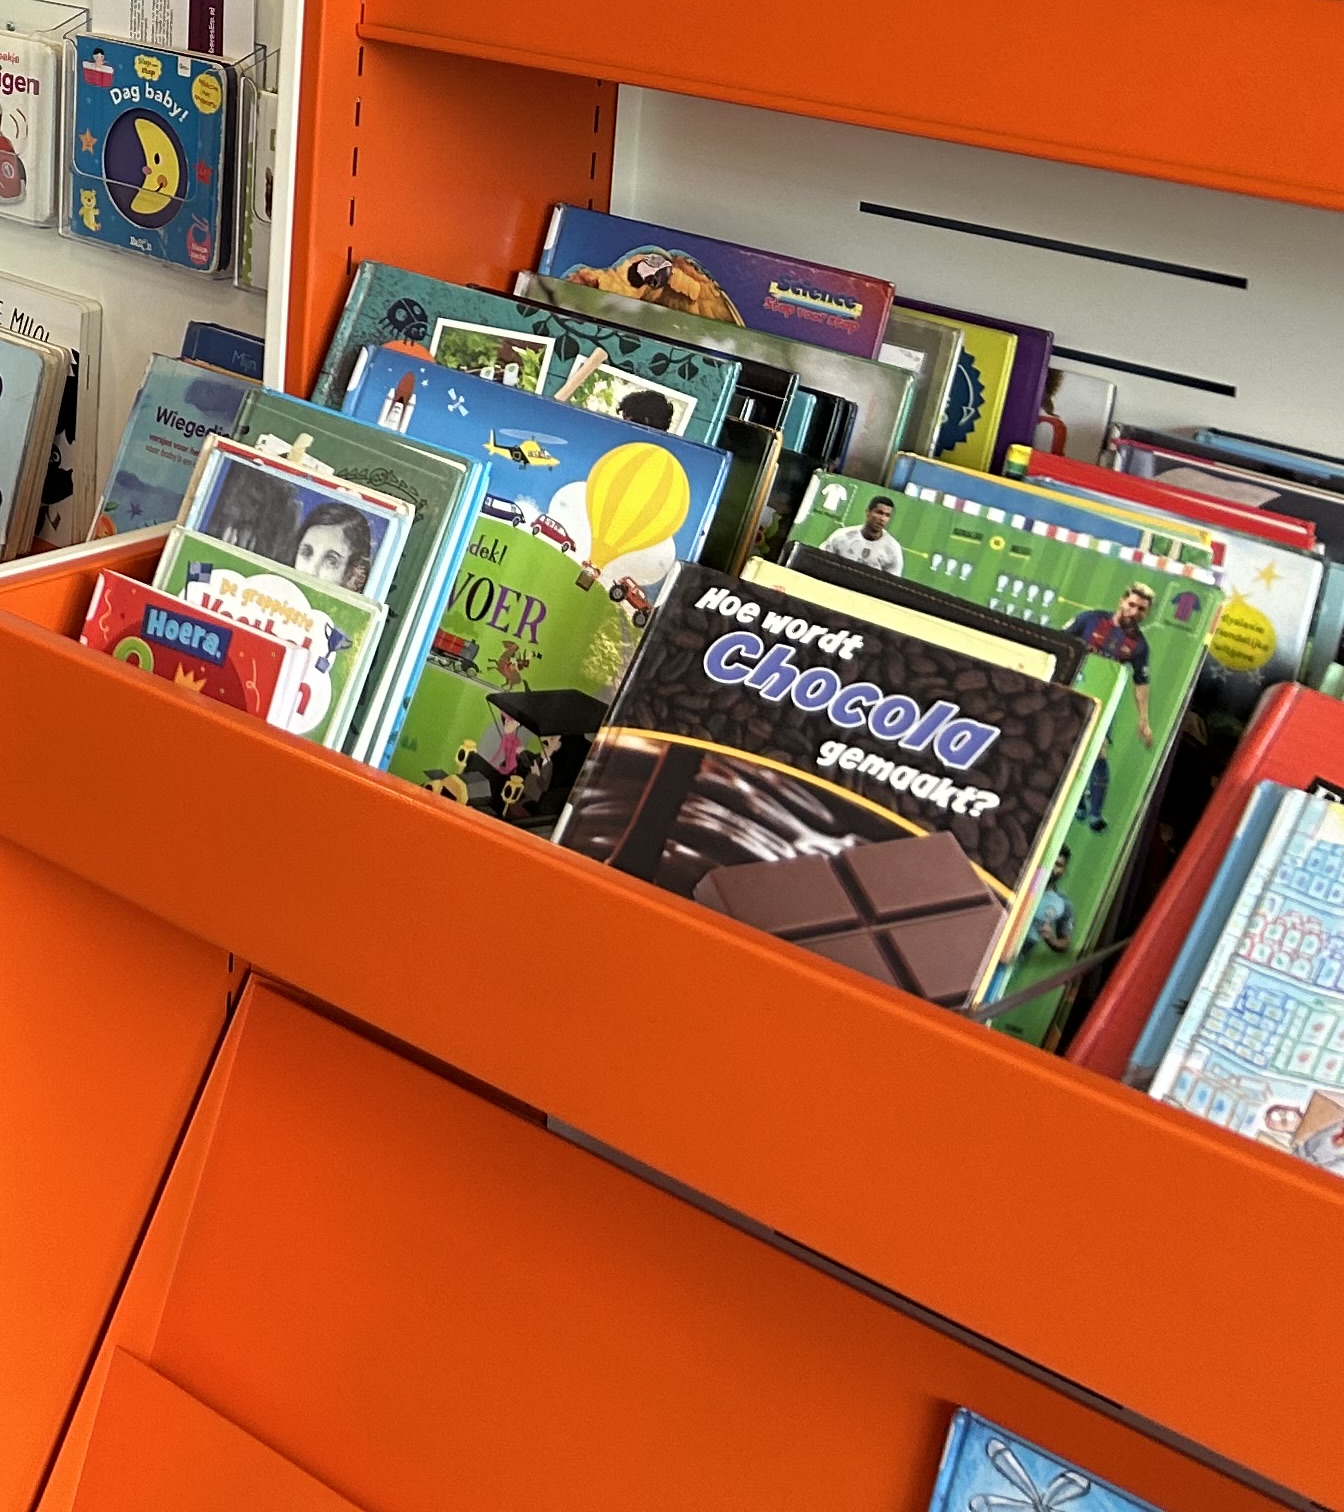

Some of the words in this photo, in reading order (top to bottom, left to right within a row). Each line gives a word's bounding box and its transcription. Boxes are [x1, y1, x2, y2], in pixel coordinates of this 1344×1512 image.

[109, 85, 141, 105] Dag
[144, 80, 190, 124] baby!
[763, 296, 796, 319] Stap
[797, 306, 828, 323] voor
[826, 312, 860, 335] stap
[776, 274, 858, 310] Science
[220, 577, 238, 597] De
[447, 571, 547, 645] VOER
[694, 585, 762, 625] Hoe
[760, 607, 865, 661] wordt
[703, 630, 1002, 772] Chocola
[816, 740, 1002, 818] gemaakt?
